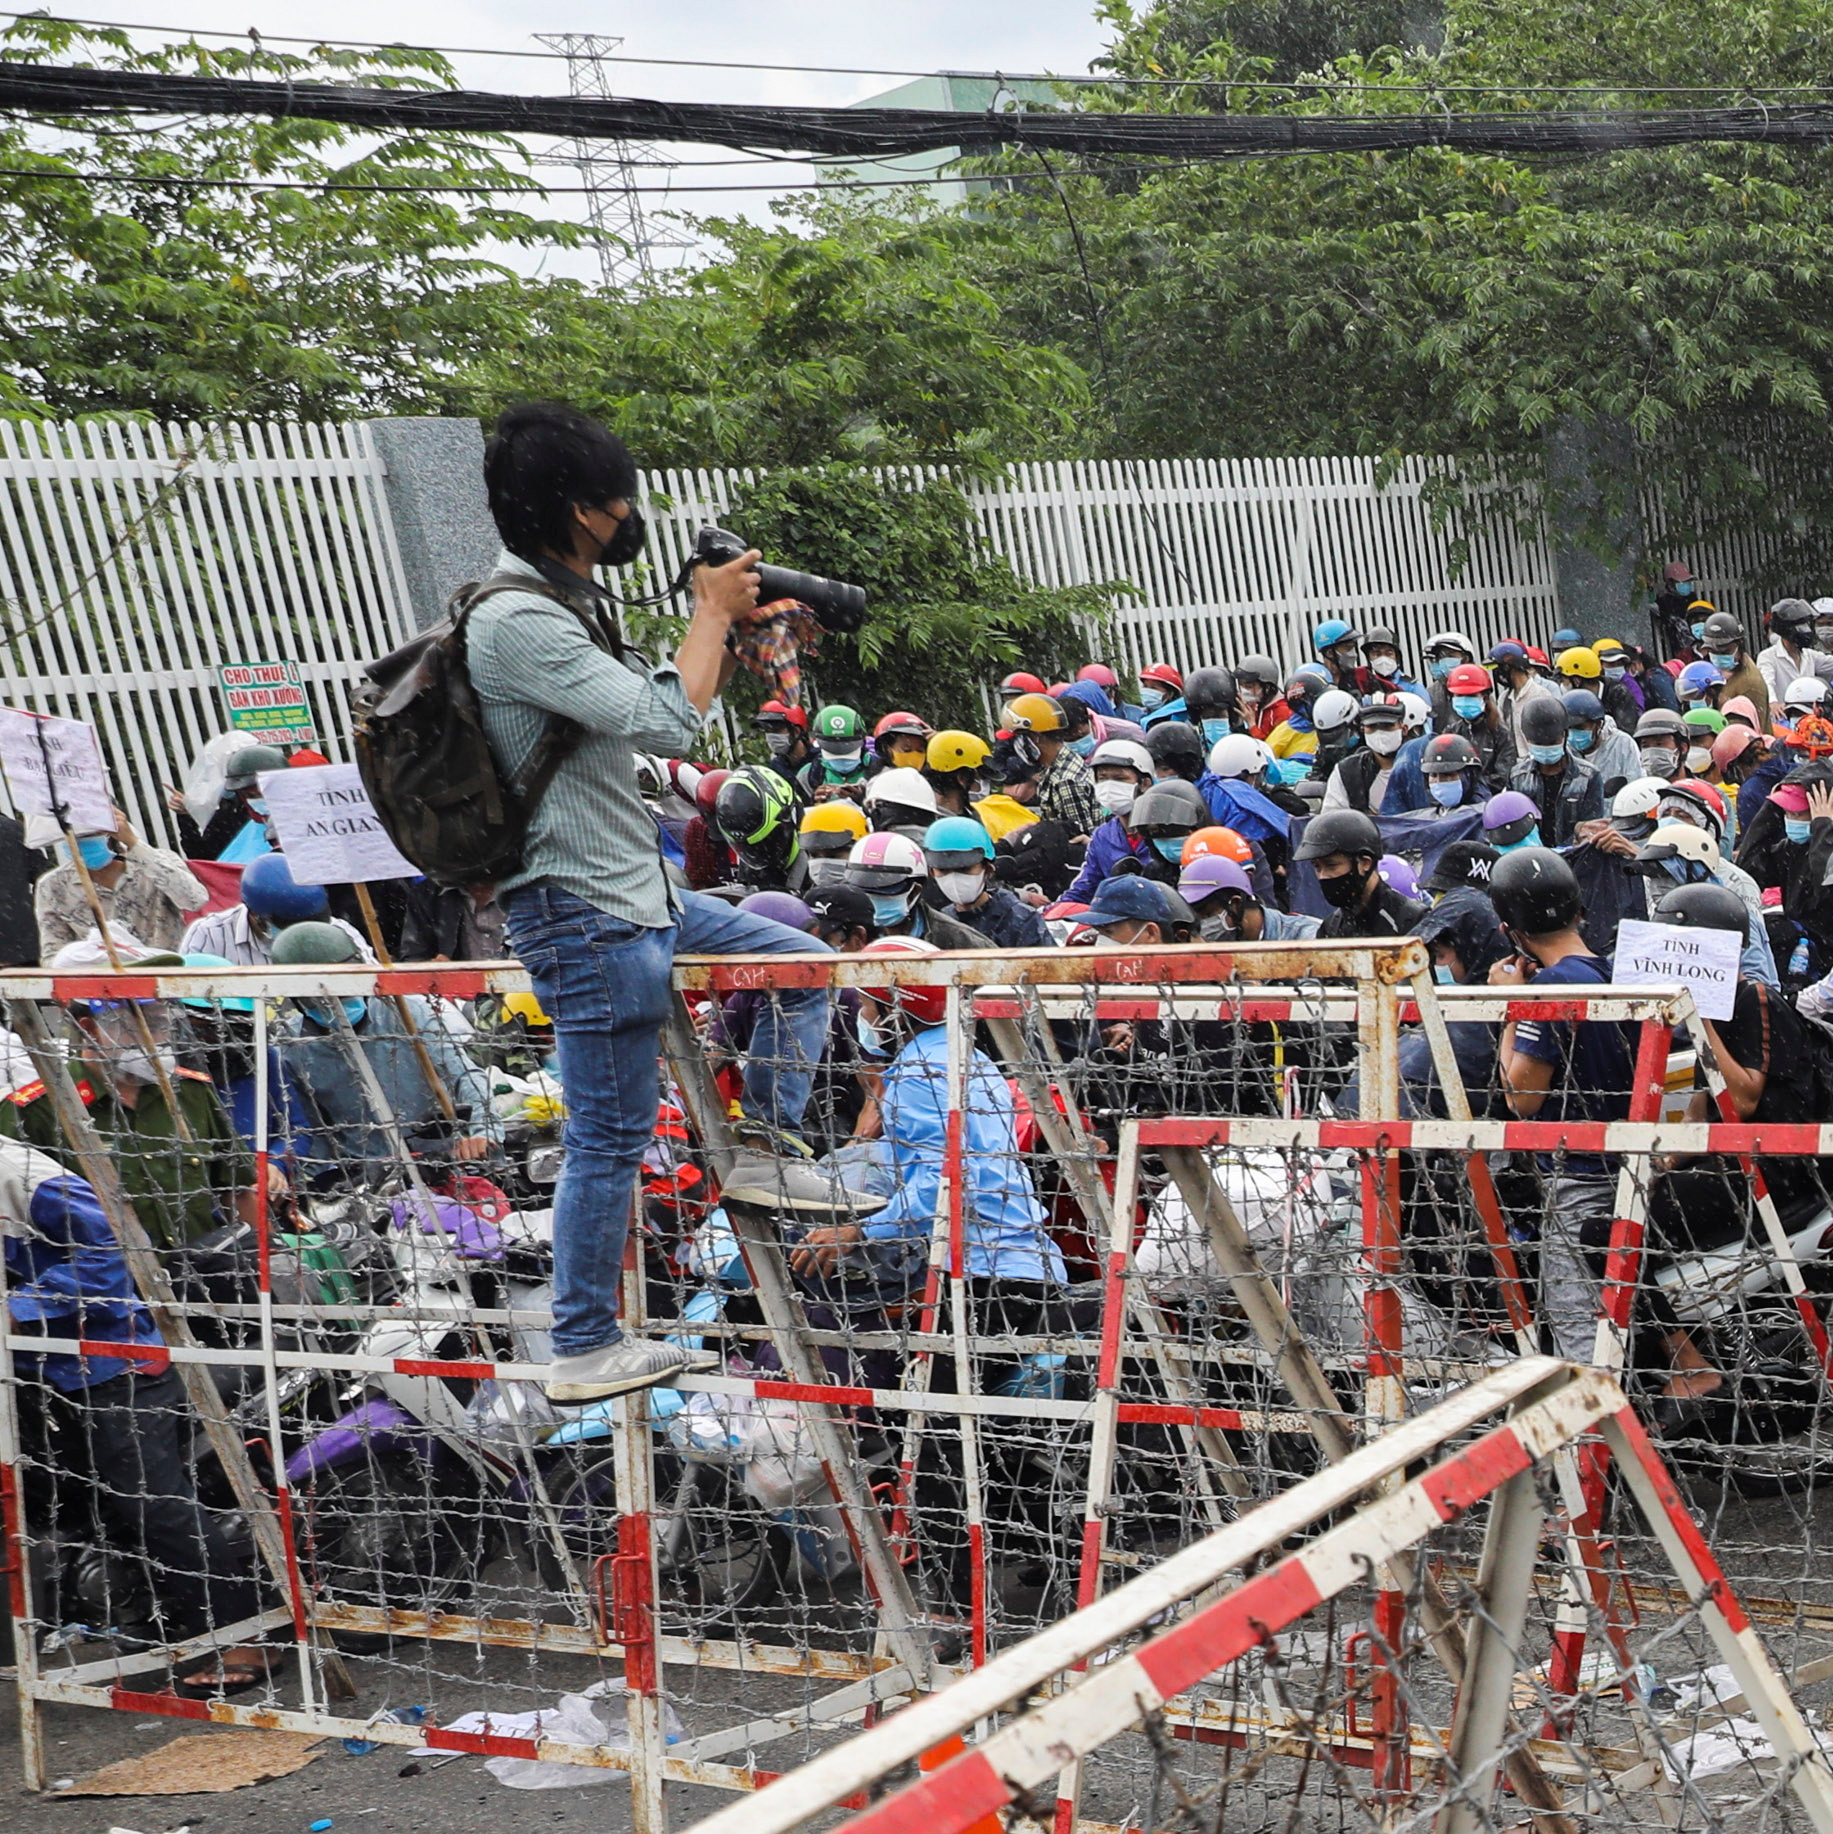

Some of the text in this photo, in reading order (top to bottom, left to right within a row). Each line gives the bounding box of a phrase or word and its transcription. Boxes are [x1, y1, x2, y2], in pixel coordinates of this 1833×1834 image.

[223, 667, 252, 685] CHO
[254, 662, 288, 684] THUÊ
[229, 688, 251, 708] BÁN
[251, 688, 273, 706] KHO
[317, 786, 366, 808] TỈNH
[306, 815, 384, 838] AN GIAN
[1662, 937, 1700, 956] TỈNH
[1633, 957, 1727, 983] VĨNH LONG
